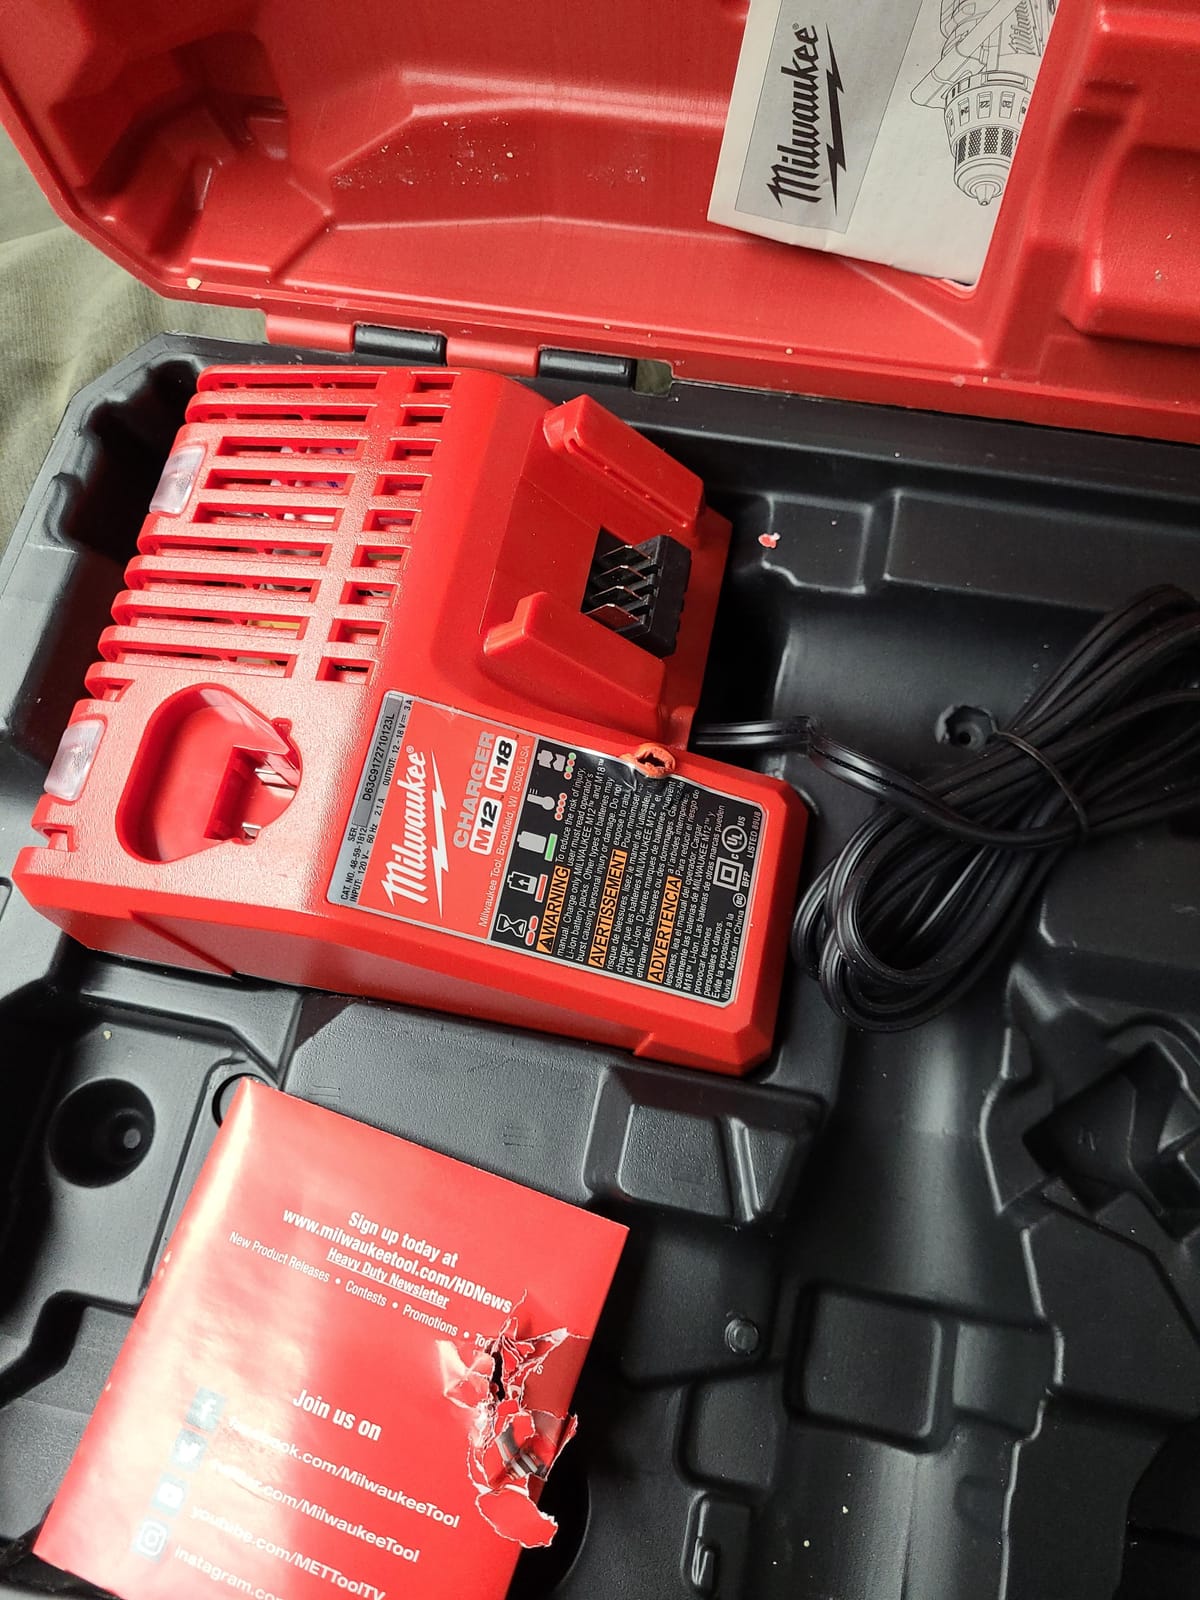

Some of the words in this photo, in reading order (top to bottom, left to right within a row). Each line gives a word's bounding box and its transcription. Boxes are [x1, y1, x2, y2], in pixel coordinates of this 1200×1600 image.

[362, 713, 395, 801] D63C9172710123L
[517, 743, 530, 764] USA
[451, 730, 495, 850] CHARGER
[511, 764, 526, 792] 53005
[592, 784, 601, 799] and
[603, 776, 615, 793] may
[473, 800, 499, 851] M12
[489, 739, 514, 788] M18
[559, 826, 571, 853] reduce
[567, 798, 577, 812] risk
[572, 768, 586, 789] injury,
[595, 794, 610, 826] batteries
[347, 826, 358, 842] SER.
[349, 879, 362, 902] INPUT:
[382, 757, 396, 786] OUTPUT:
[495, 808, 515, 856] Brookfield,
[575, 810, 585, 828] read
[602, 811, 616, 843] damage.
[613, 818, 624, 846] expose
[620, 830, 632, 848] Pour
[626, 793, 640, 829] minimiser
[714, 805, 725, 832] pueden
[571, 829, 581, 848] must
[573, 826, 592, 876] MILWAUKEE
[588, 837, 600, 857] types
[634, 828, 652, 878] MILWAUKEE
[644, 856, 656, 889] marques
[652, 811, 666, 843] batteries
[675, 858, 685, 876] Para
[680, 831, 690, 857] reducir
[686, 800, 697, 823] riesgo
[709, 833, 720, 860] marcas
[746, 830, 758, 859] LISTED
[567, 849, 576, 866] user
[582, 858, 596, 880] Other
[594, 853, 608, 874] injury
[655, 862, 665, 877] des
[705, 861, 714, 880] otras
[571, 876, 582, 893] only
[675, 899, 687, 928] manual
[690, 823, 702, 849] Cargar
[340, 885, 351, 900] CAT.
[478, 879, 498, 928] Milwaukee
[541, 866, 570, 937] WARNING
[589, 875, 601, 909] personal
[590, 850, 626, 966] AVERTISSEMENT
[627, 879, 641, 912] batteries
[645, 889, 660, 926] blessures
[562, 894, 577, 923] Charge
[570, 908, 585, 935] battery
[606, 945, 617, 970] risque
[621, 874, 632, 892] lisez
[675, 948, 688, 988] solamente
[692, 842, 708, 891] MILWAUKEE
[557, 926, 569, 956] manual.
[582, 910, 596, 940] causing
[623, 926, 632, 941] que
[642, 927, 652, 942] des
[649, 876, 681, 982] ADVERTENCIA
[693, 924, 703, 938] Las
[726, 946, 737, 971] Made
[733, 910, 744, 934] China
[575, 941, 587, 962] burst
[616, 942, 629, 972] charger
[699, 927, 712, 958] lesiones
[694, 959, 706, 994] provocar
[703, 954, 717, 997] personales
[711, 979, 722, 999] Evite
[348, 1211, 380, 1238] Sign
[381, 1227, 402, 1248] up
[402, 1232, 442, 1264] today
[442, 1251, 460, 1269] at
[282, 1209, 514, 1315] www.milwaukeetool.com/HDNews
[327, 1247, 362, 1273] Heavy
[362, 1262, 390, 1285] Duty
[389, 1272, 451, 1309] Newsletter
[229, 1231, 252, 1250] New
[252, 1240, 289, 1266] Product
[288, 1256, 331, 1283] Releases
[345, 1280, 388, 1308] Contests
[402, 1304, 459, 1337] Promotions
[293, 1388, 331, 1421] Join
[332, 1405, 356, 1431] us
[358, 1419, 383, 1442] on
